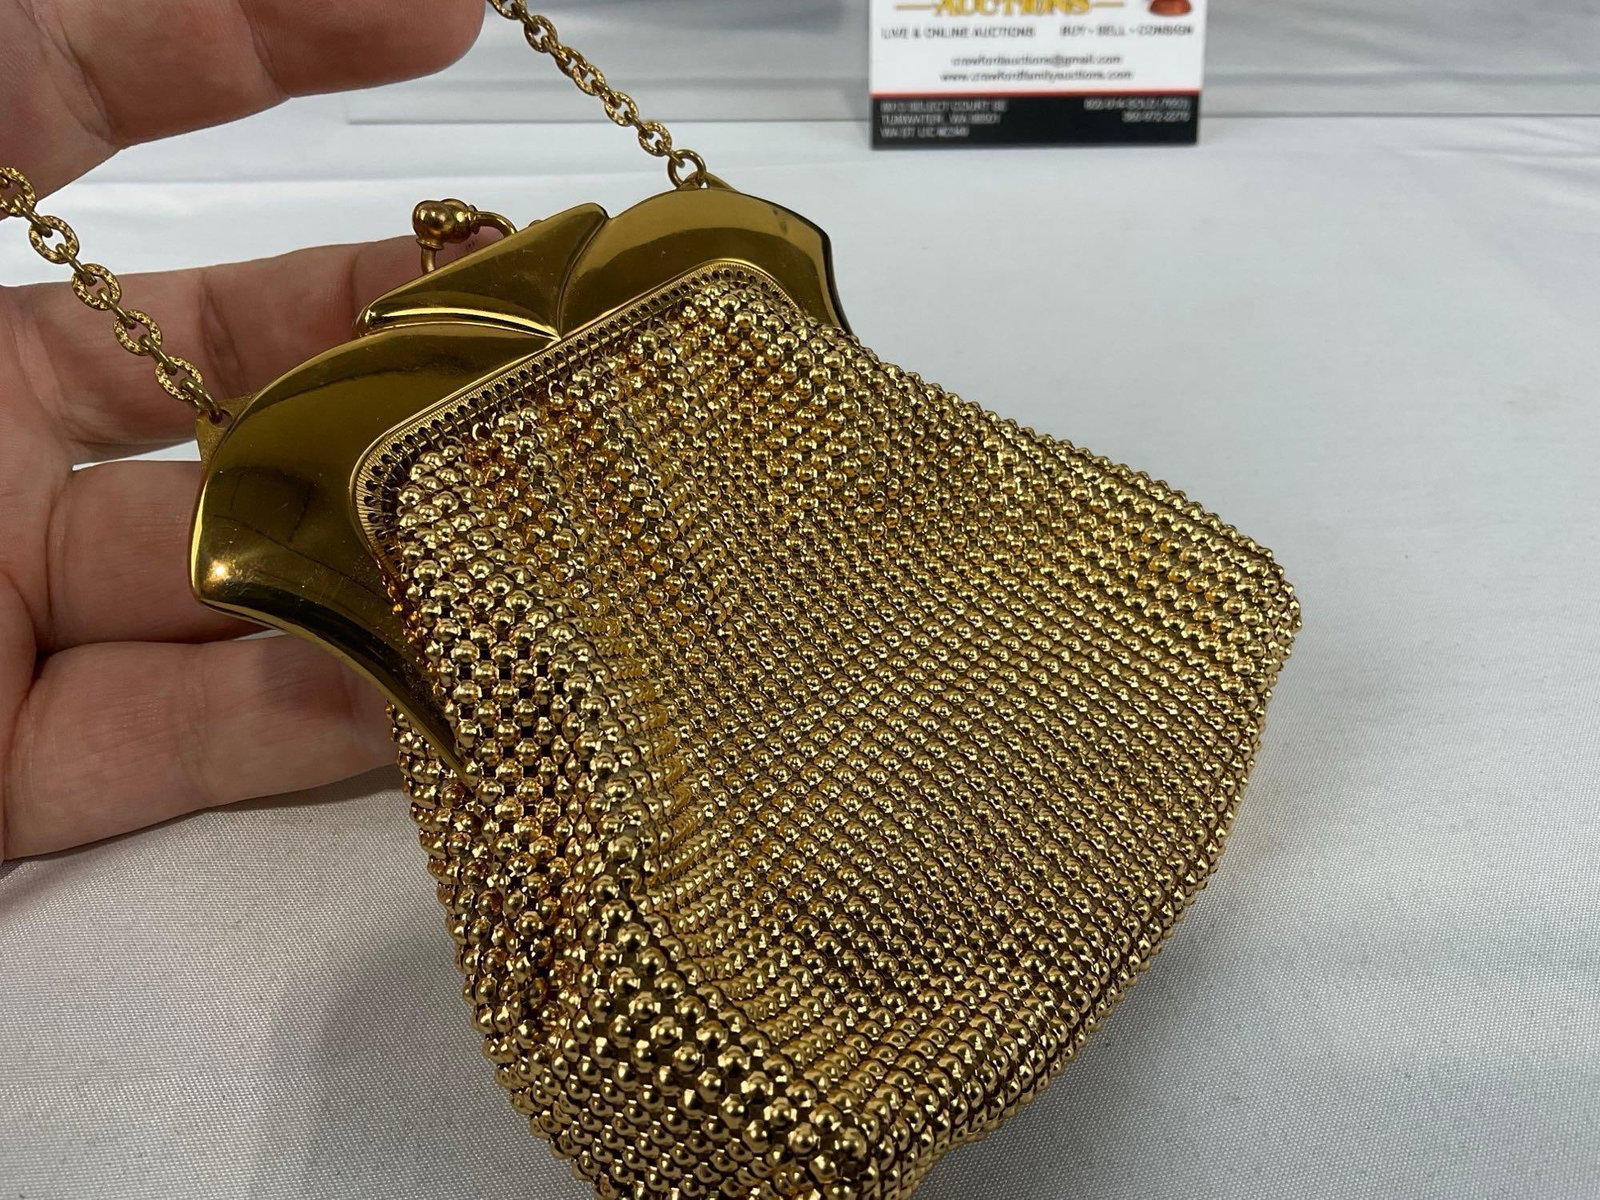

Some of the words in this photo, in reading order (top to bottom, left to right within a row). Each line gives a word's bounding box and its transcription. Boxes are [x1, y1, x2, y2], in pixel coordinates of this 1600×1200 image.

[935, 0, 1090, 16] AUCTIONS
[924, 26, 968, 39] ONLINE
[973, 25, 1035, 39] AUCTIONS
[1096, 24, 1125, 37] SELL
[1137, 24, 1193, 37] CONSIGN
